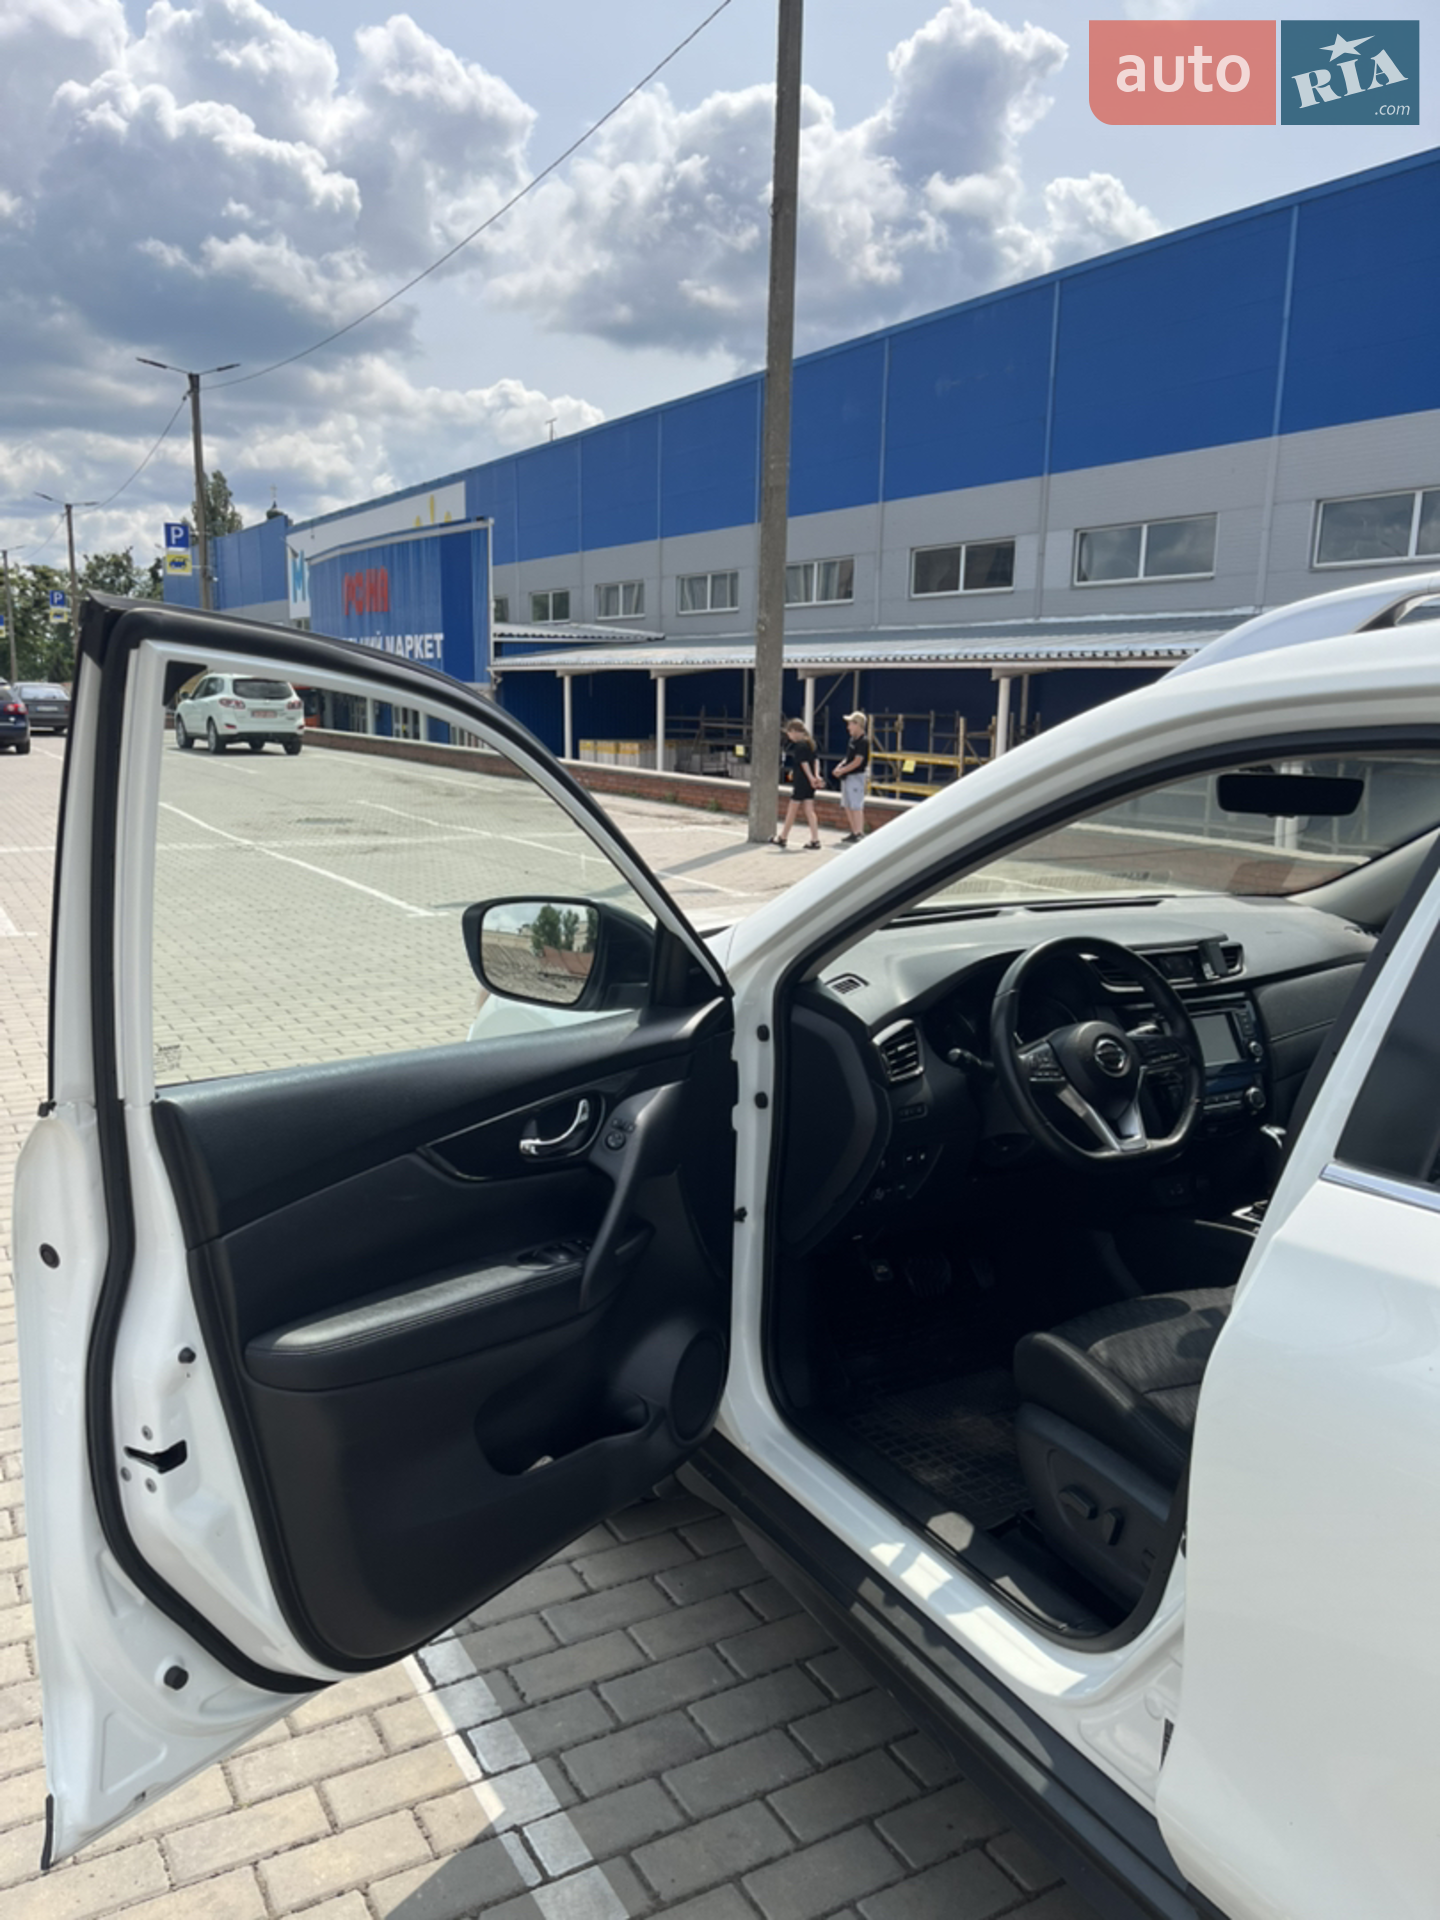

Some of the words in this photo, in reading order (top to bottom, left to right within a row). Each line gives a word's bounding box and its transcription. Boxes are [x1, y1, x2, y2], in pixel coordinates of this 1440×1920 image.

[170, 525, 184, 545] P
[53, 591, 63, 604] P
[385, 633, 444, 659] МАРКЕТ
